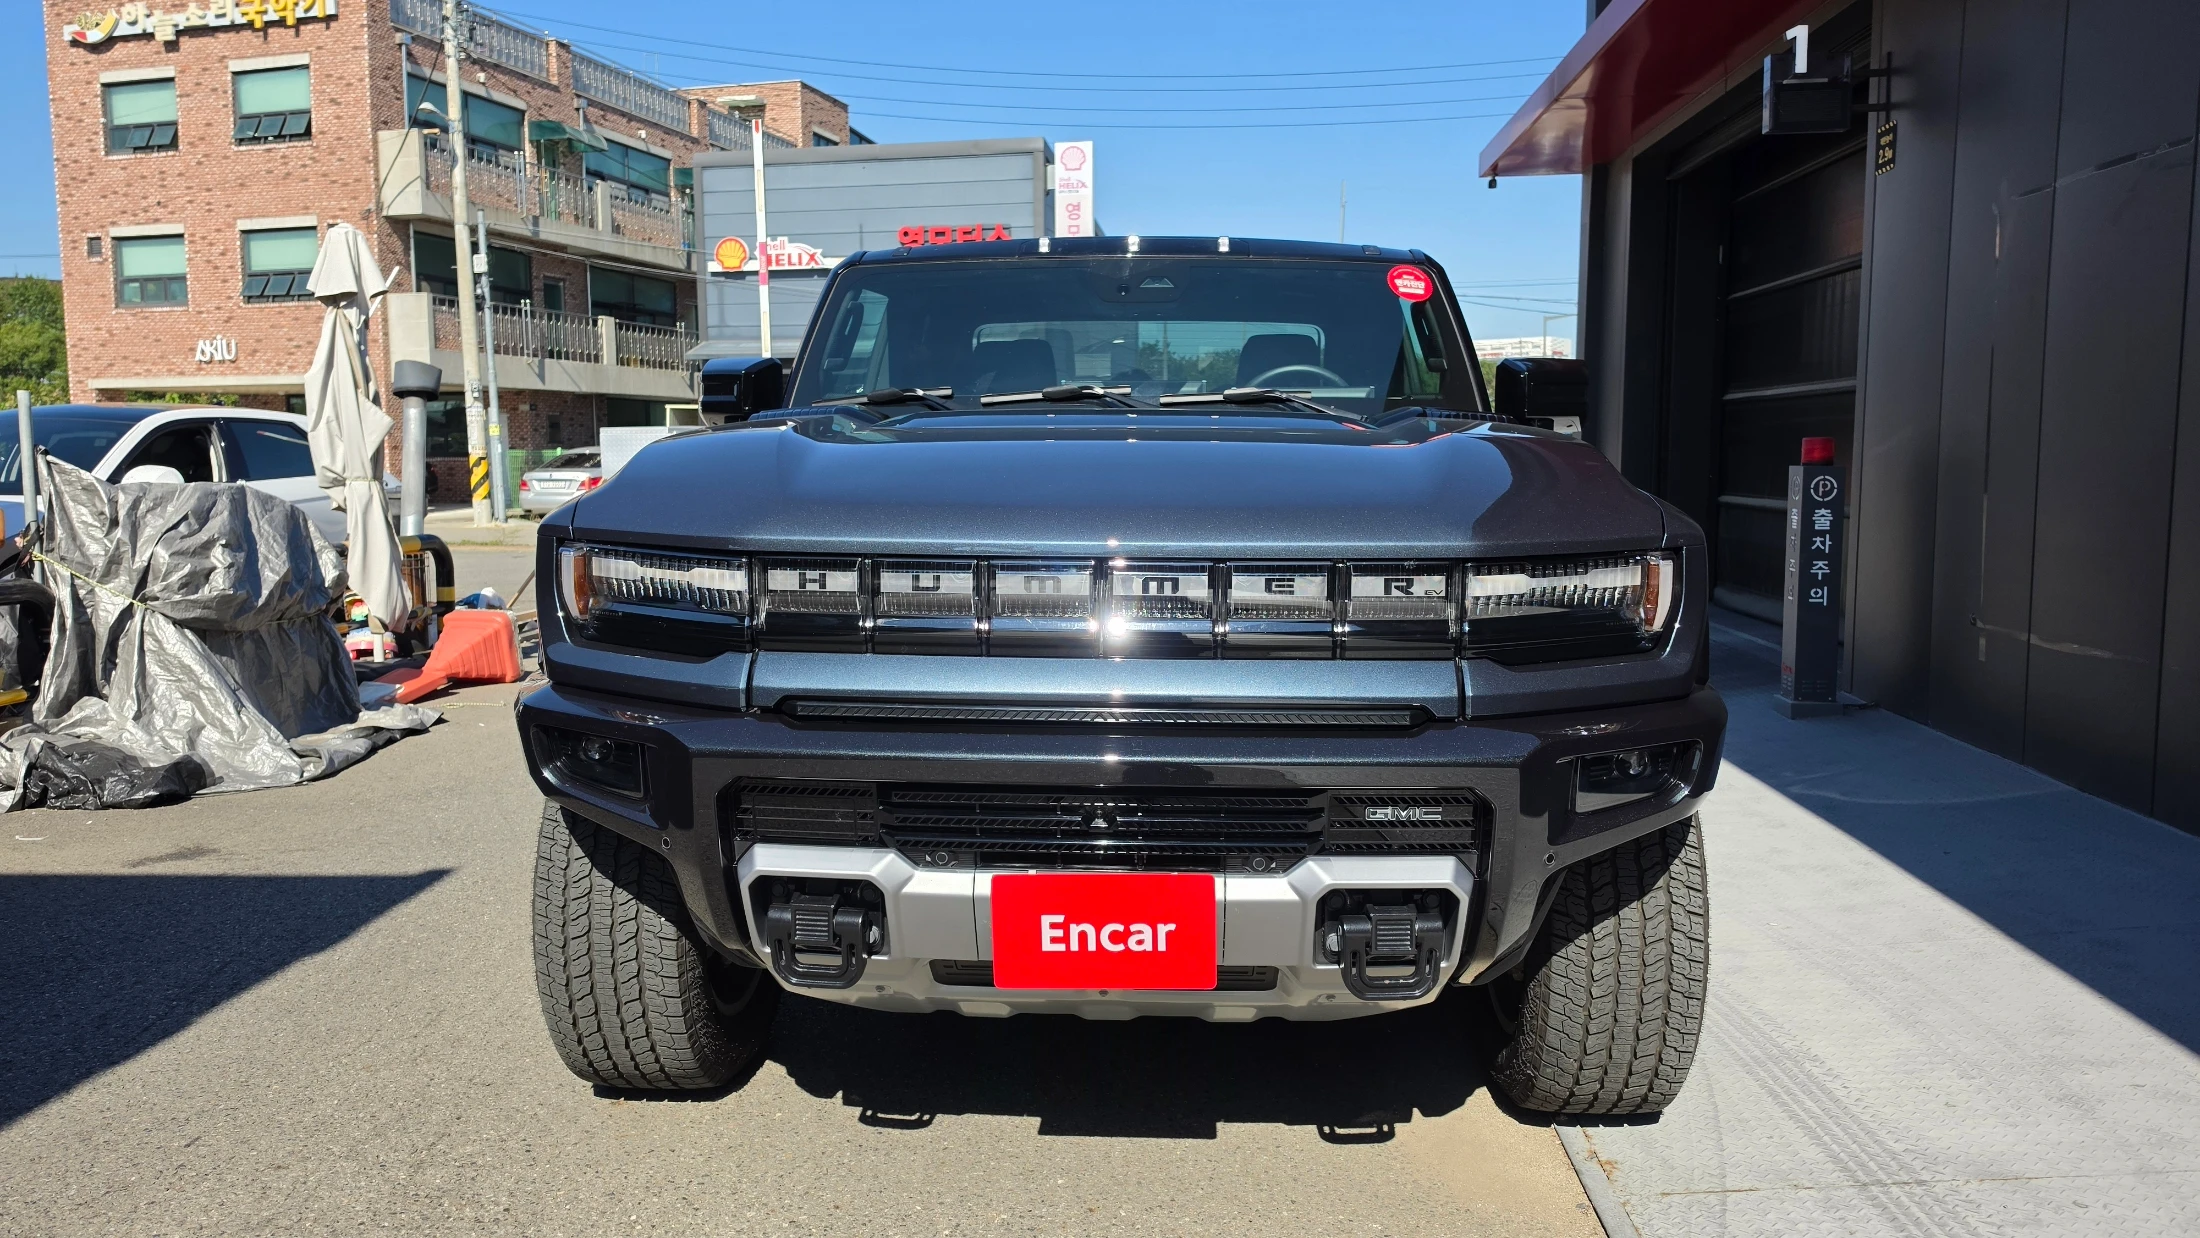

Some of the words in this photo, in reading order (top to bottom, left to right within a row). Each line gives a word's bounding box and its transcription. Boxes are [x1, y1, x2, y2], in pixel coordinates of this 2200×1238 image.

[1785, 24, 1809, 73] 1
[765, 239, 786, 251] hell
[1808, 507, 1834, 607] 출차주의
[1365, 805, 1443, 821] GMC
[1040, 914, 1177, 952] Encar
